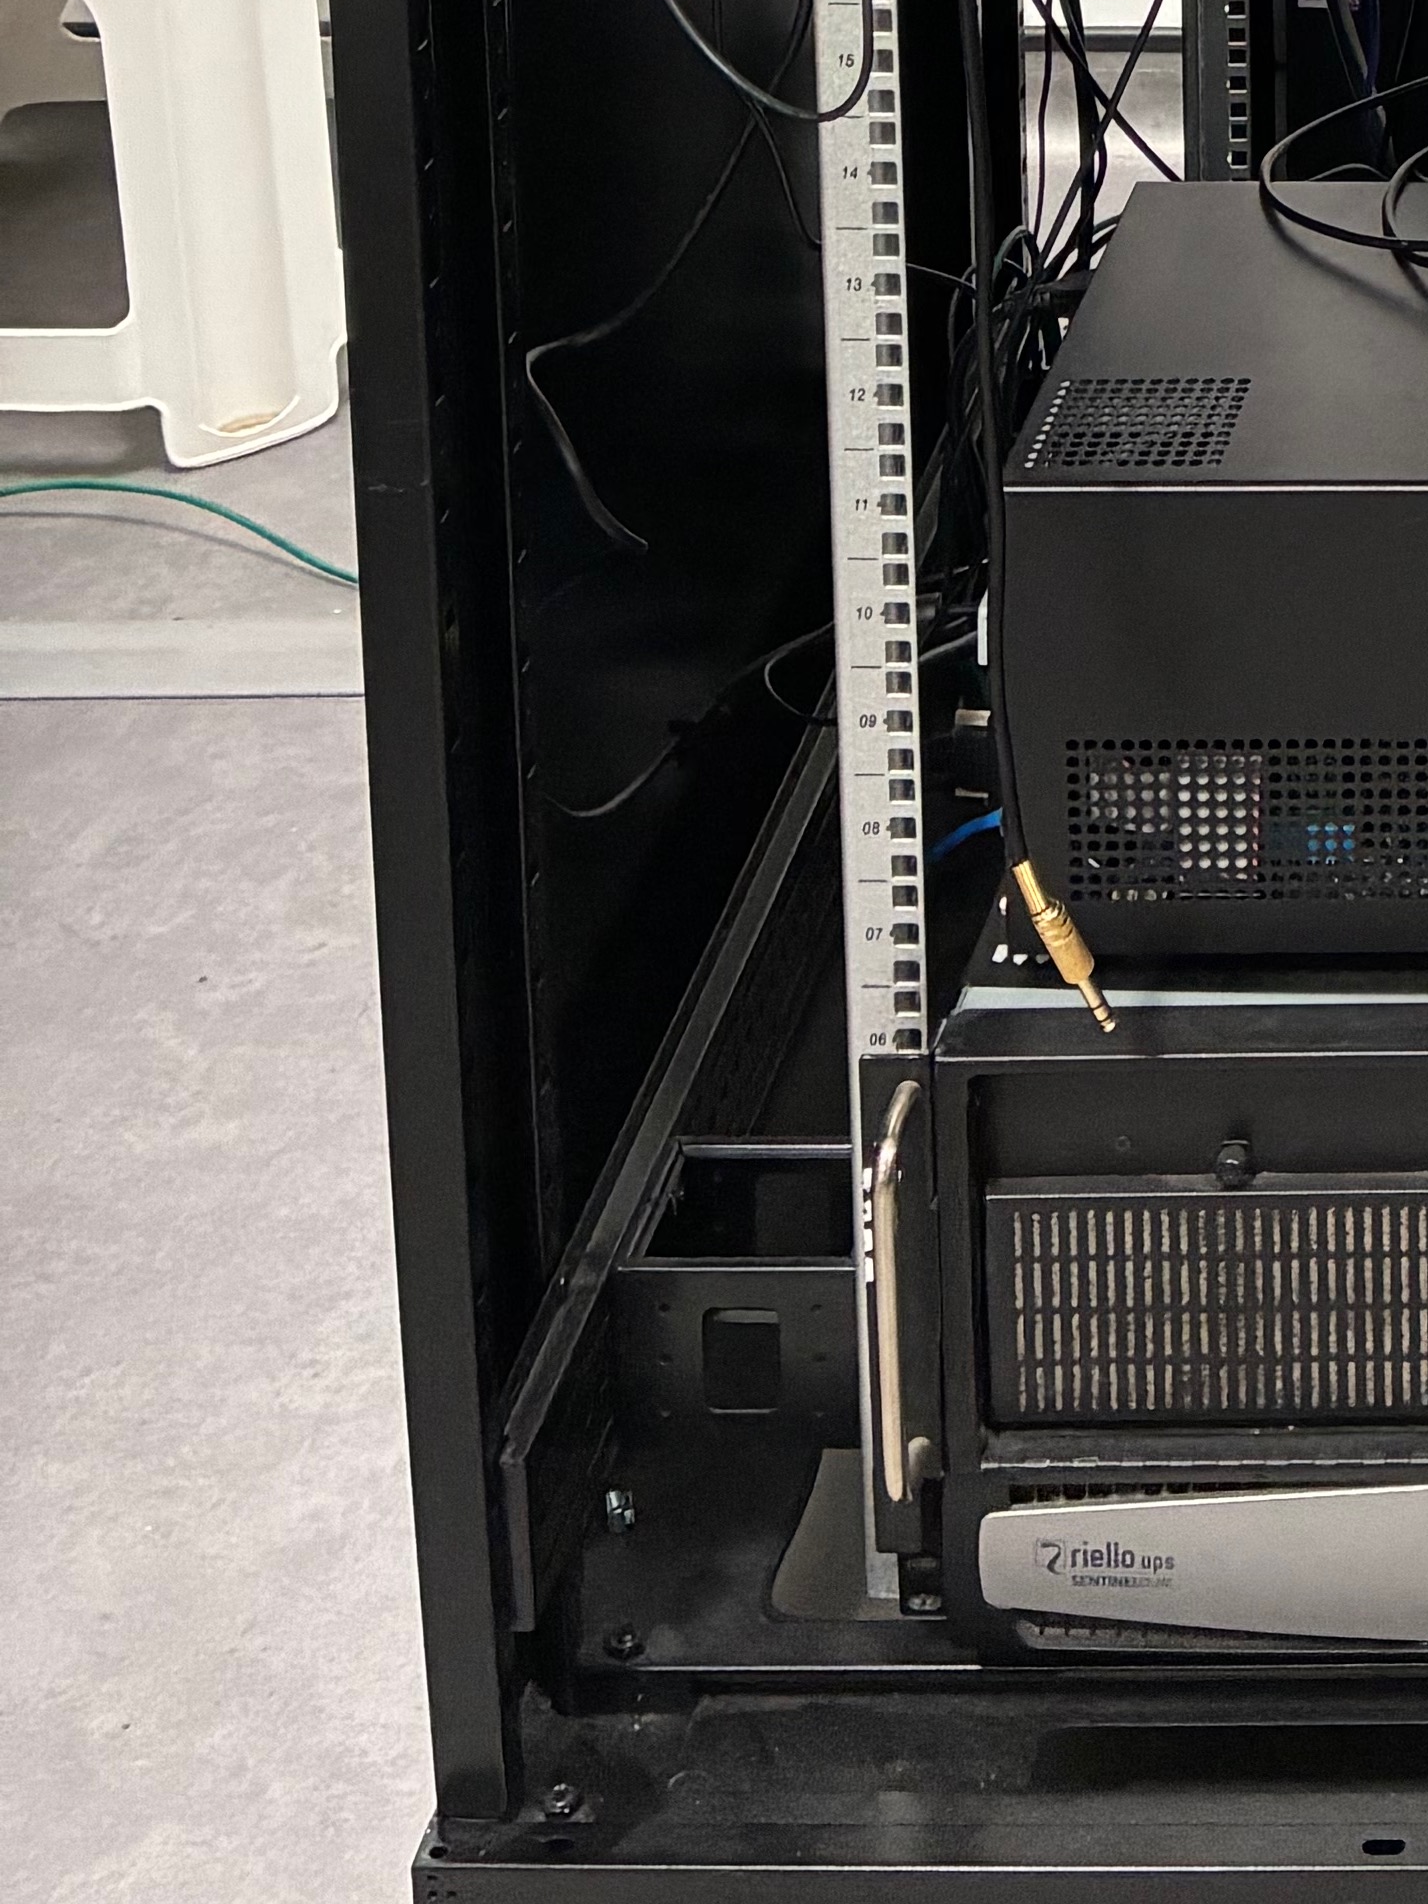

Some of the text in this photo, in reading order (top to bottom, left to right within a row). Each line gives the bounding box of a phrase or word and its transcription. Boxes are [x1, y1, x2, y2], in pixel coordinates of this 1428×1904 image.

[838, 53, 855, 69] 15
[842, 165, 858, 180] 14
[845, 277, 862, 292] 13
[849, 388, 866, 402] 12
[854, 498, 868, 512] 11
[856, 607, 872, 621] 10
[858, 714, 877, 728] 09
[861, 821, 880, 836] 08
[866, 927, 883, 941] 07
[868, 1032, 887, 1047] 06
[1070, 1540, 1175, 1575] riello ups
